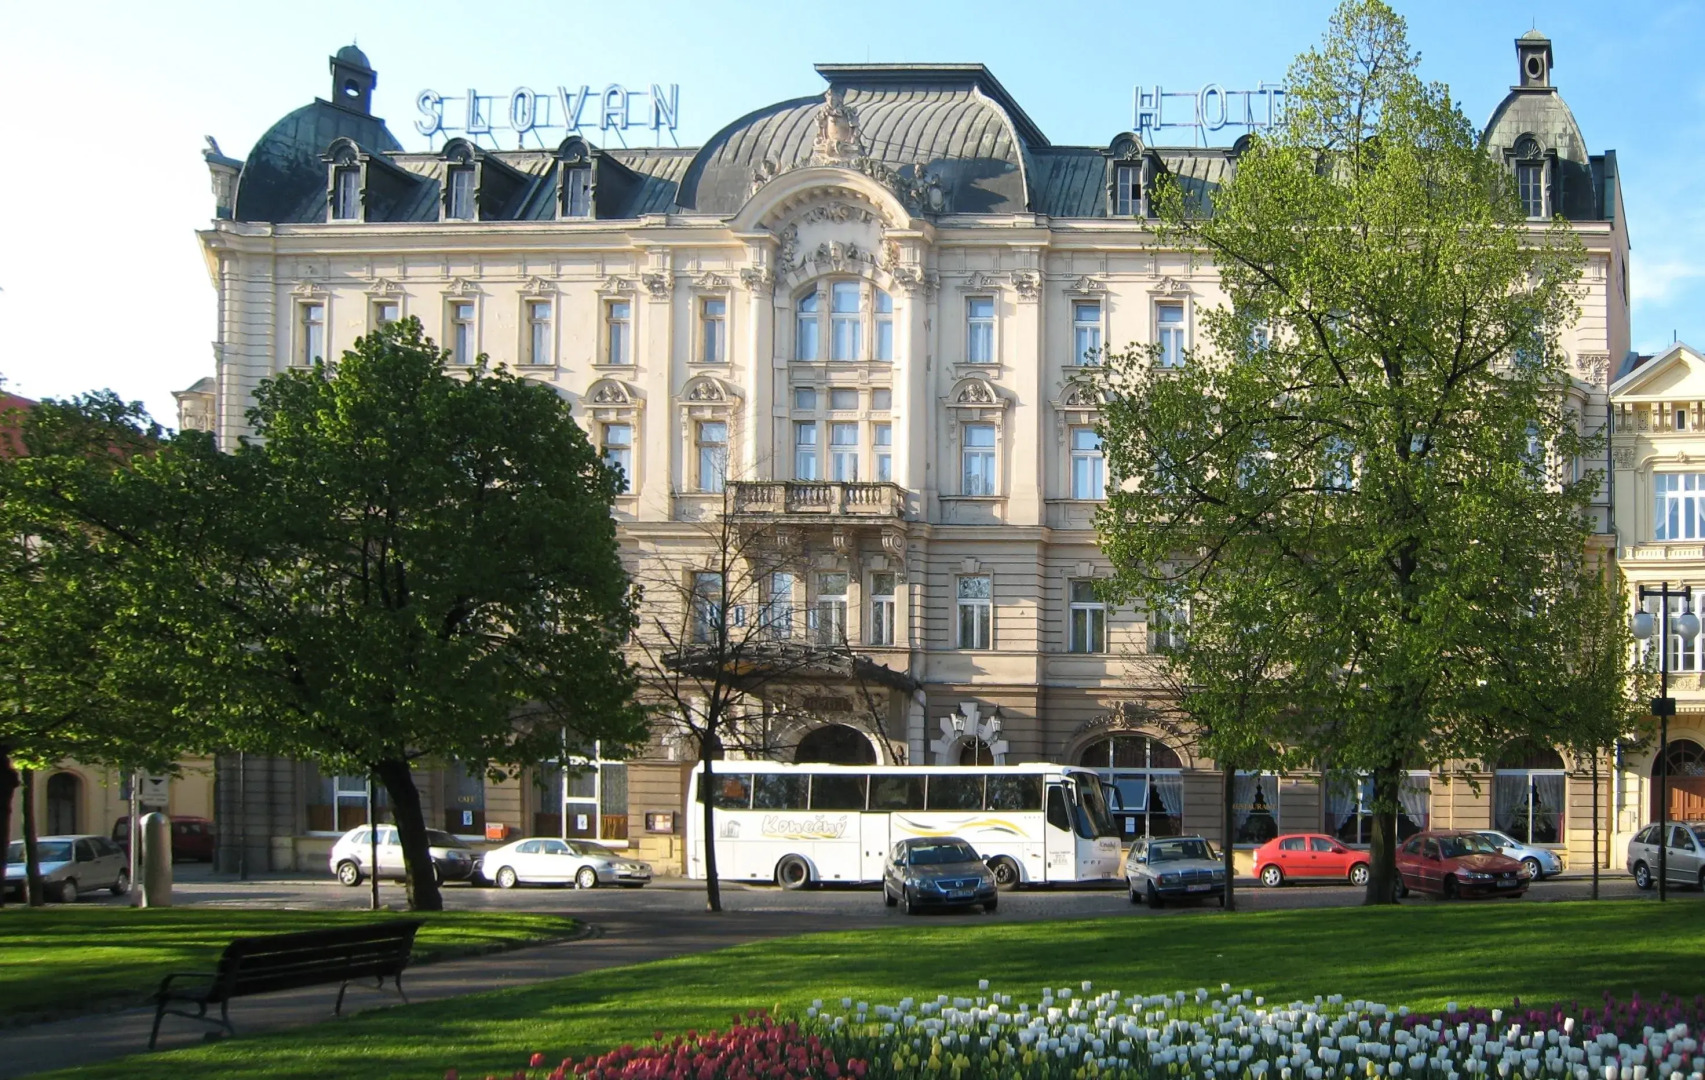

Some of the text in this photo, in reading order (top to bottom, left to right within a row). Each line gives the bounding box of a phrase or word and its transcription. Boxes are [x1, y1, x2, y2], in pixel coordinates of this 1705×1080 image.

[413, 83, 679, 137] SLOVAN
[1133, 80, 1342, 132] HOT
[761, 814, 848, 839] Konečný
